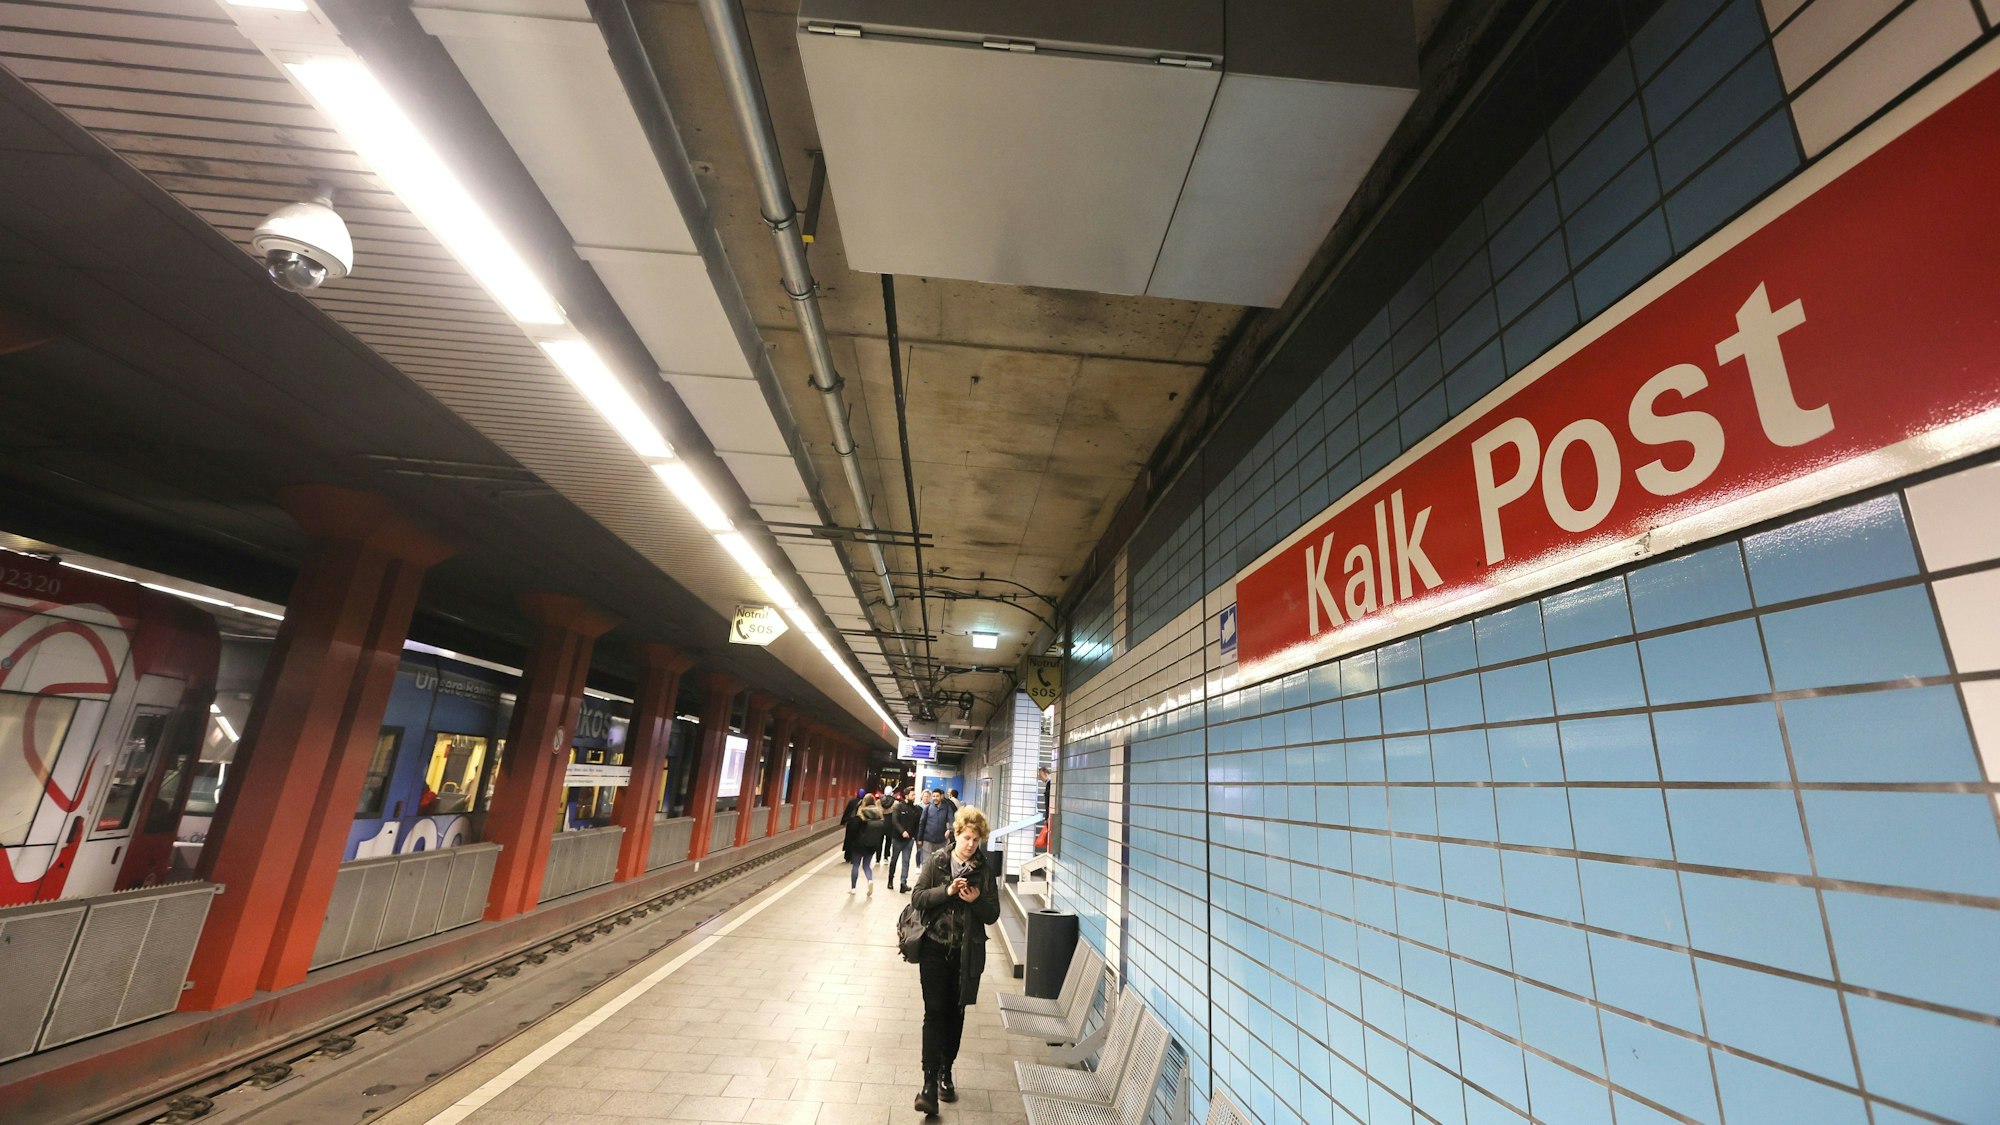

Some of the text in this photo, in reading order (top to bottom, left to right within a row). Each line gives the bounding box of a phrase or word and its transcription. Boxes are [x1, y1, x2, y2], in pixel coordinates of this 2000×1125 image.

[1305, 281, 1835, 636] Kalk Post
[736, 606, 769, 619] Notruf
[749, 624, 773, 634] SOS
[1030, 657, 1062, 668] Notruf
[1032, 687, 1056, 697] SOS
